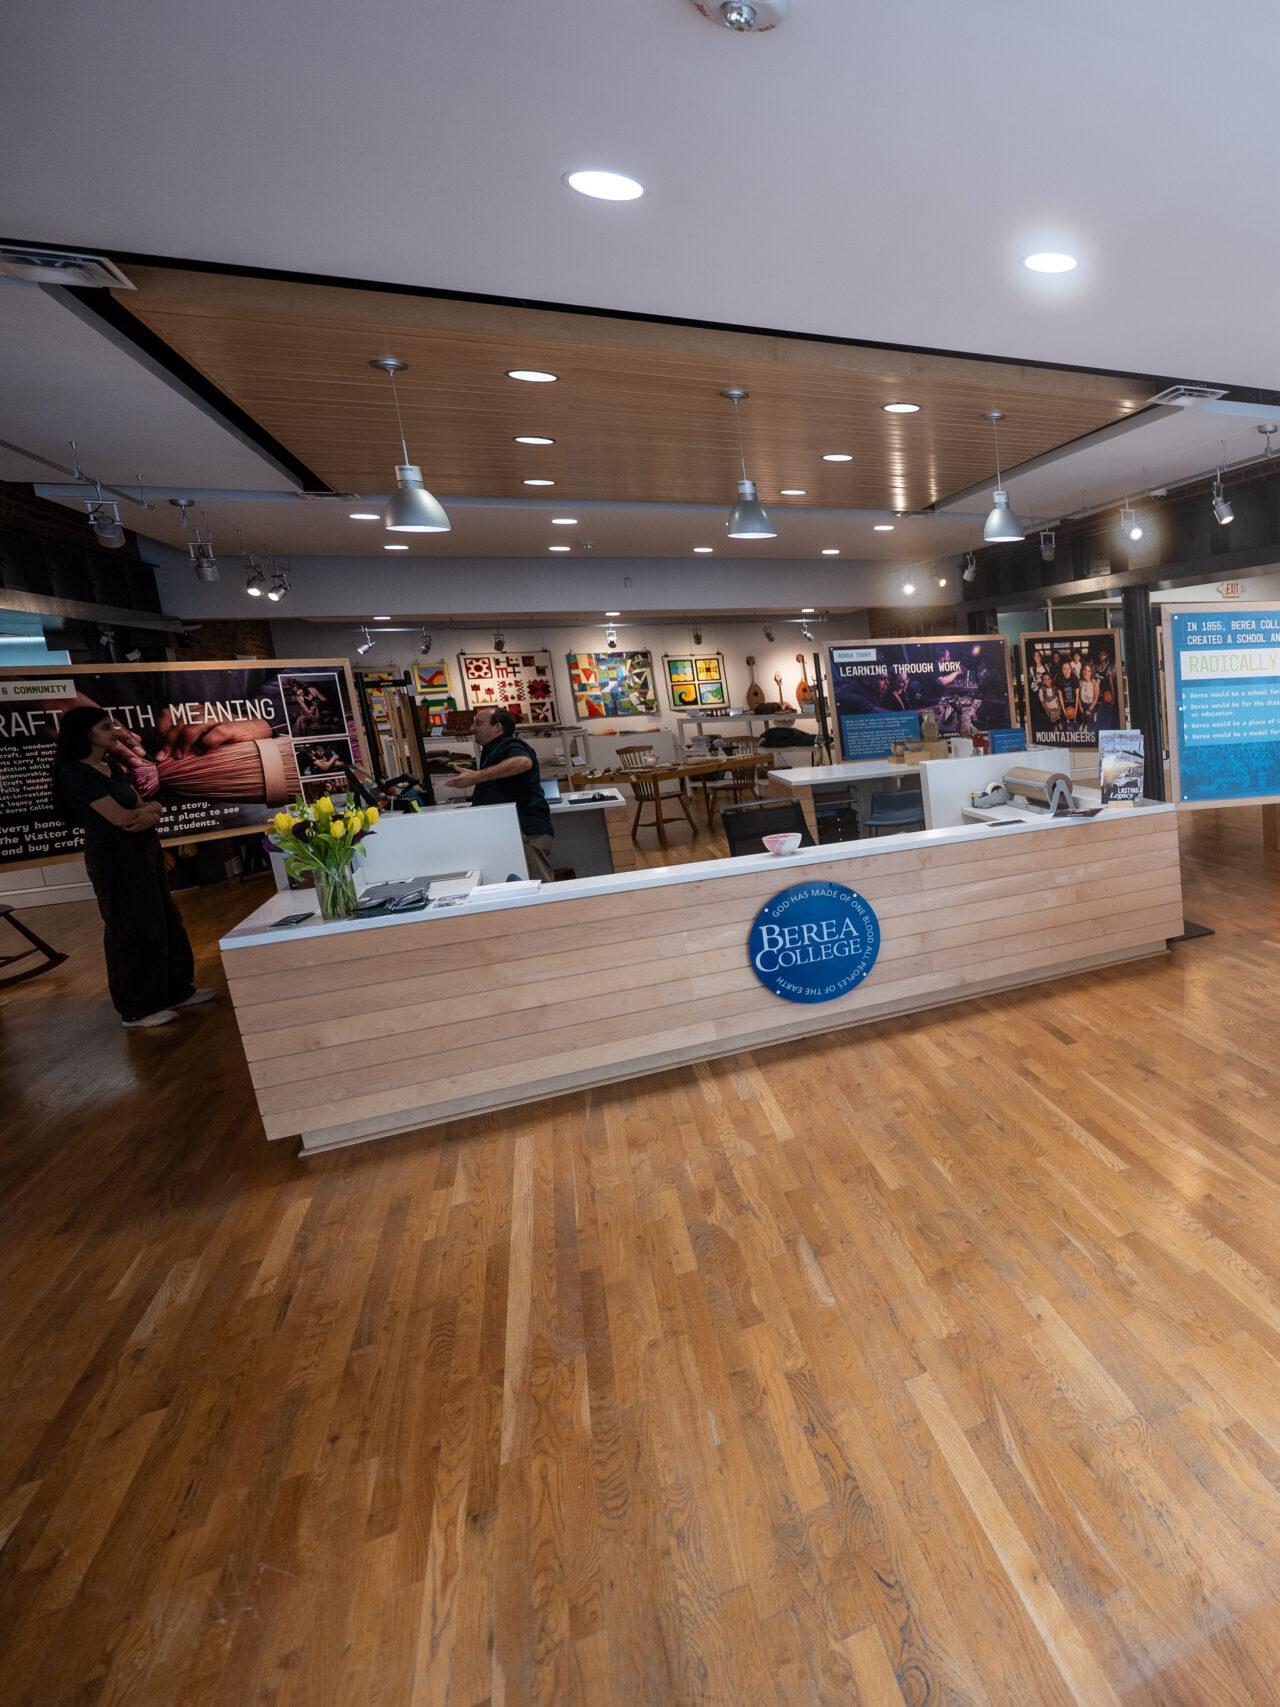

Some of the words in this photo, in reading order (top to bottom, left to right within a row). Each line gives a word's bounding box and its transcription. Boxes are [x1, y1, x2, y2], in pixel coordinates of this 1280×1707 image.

[1187, 622, 1197, 631] IN
[1201, 621, 1226, 632] 1855,
[1231, 620, 1256, 630] BEREA
[1187, 634, 1222, 645] CREATED
[1227, 634, 1233, 643] A
[1237, 633, 1266, 643] SCHOOL
[840, 665, 887, 677] LEARNING
[893, 663, 933, 674] THROUGH
[938, 661, 961, 672] WORK
[1189, 652, 1278, 674] RADICALLY
[14, 684, 67, 695] COMMUNITY
[0, 710, 62, 738] RAFT
[102, 704, 156, 729] ITH
[169, 698, 276, 726] MEANING
[1212, 720, 1231, 728] would
[1248, 719, 1265, 727] place
[1036, 731, 1096, 743] MOUNTAINEERS
[181, 801, 211, 810] story.
[159, 815, 175, 823] est
[178, 812, 206, 821] place
[173, 820, 219, 831] students.
[24, 831, 68, 842] Visitor
[1, 845, 23, 856] and
[28, 844, 49, 852] buy
[791, 891, 809, 904] HAS
[811, 889, 838, 899] MADE
[839, 893, 852, 903] OF
[772, 901, 790, 918] GOD
[851, 900, 866, 917] ONE
[758, 917, 860, 951] BEREA
[862, 915, 874, 944] BLOOD
[755, 938, 862, 973] COLLEGE
[862, 945, 873, 960] ALL
[837, 961, 867, 989] PEOPLES
[776, 976, 803, 994] EARTH
[824, 985, 836, 993] OF
[805, 987, 822, 996] THE
